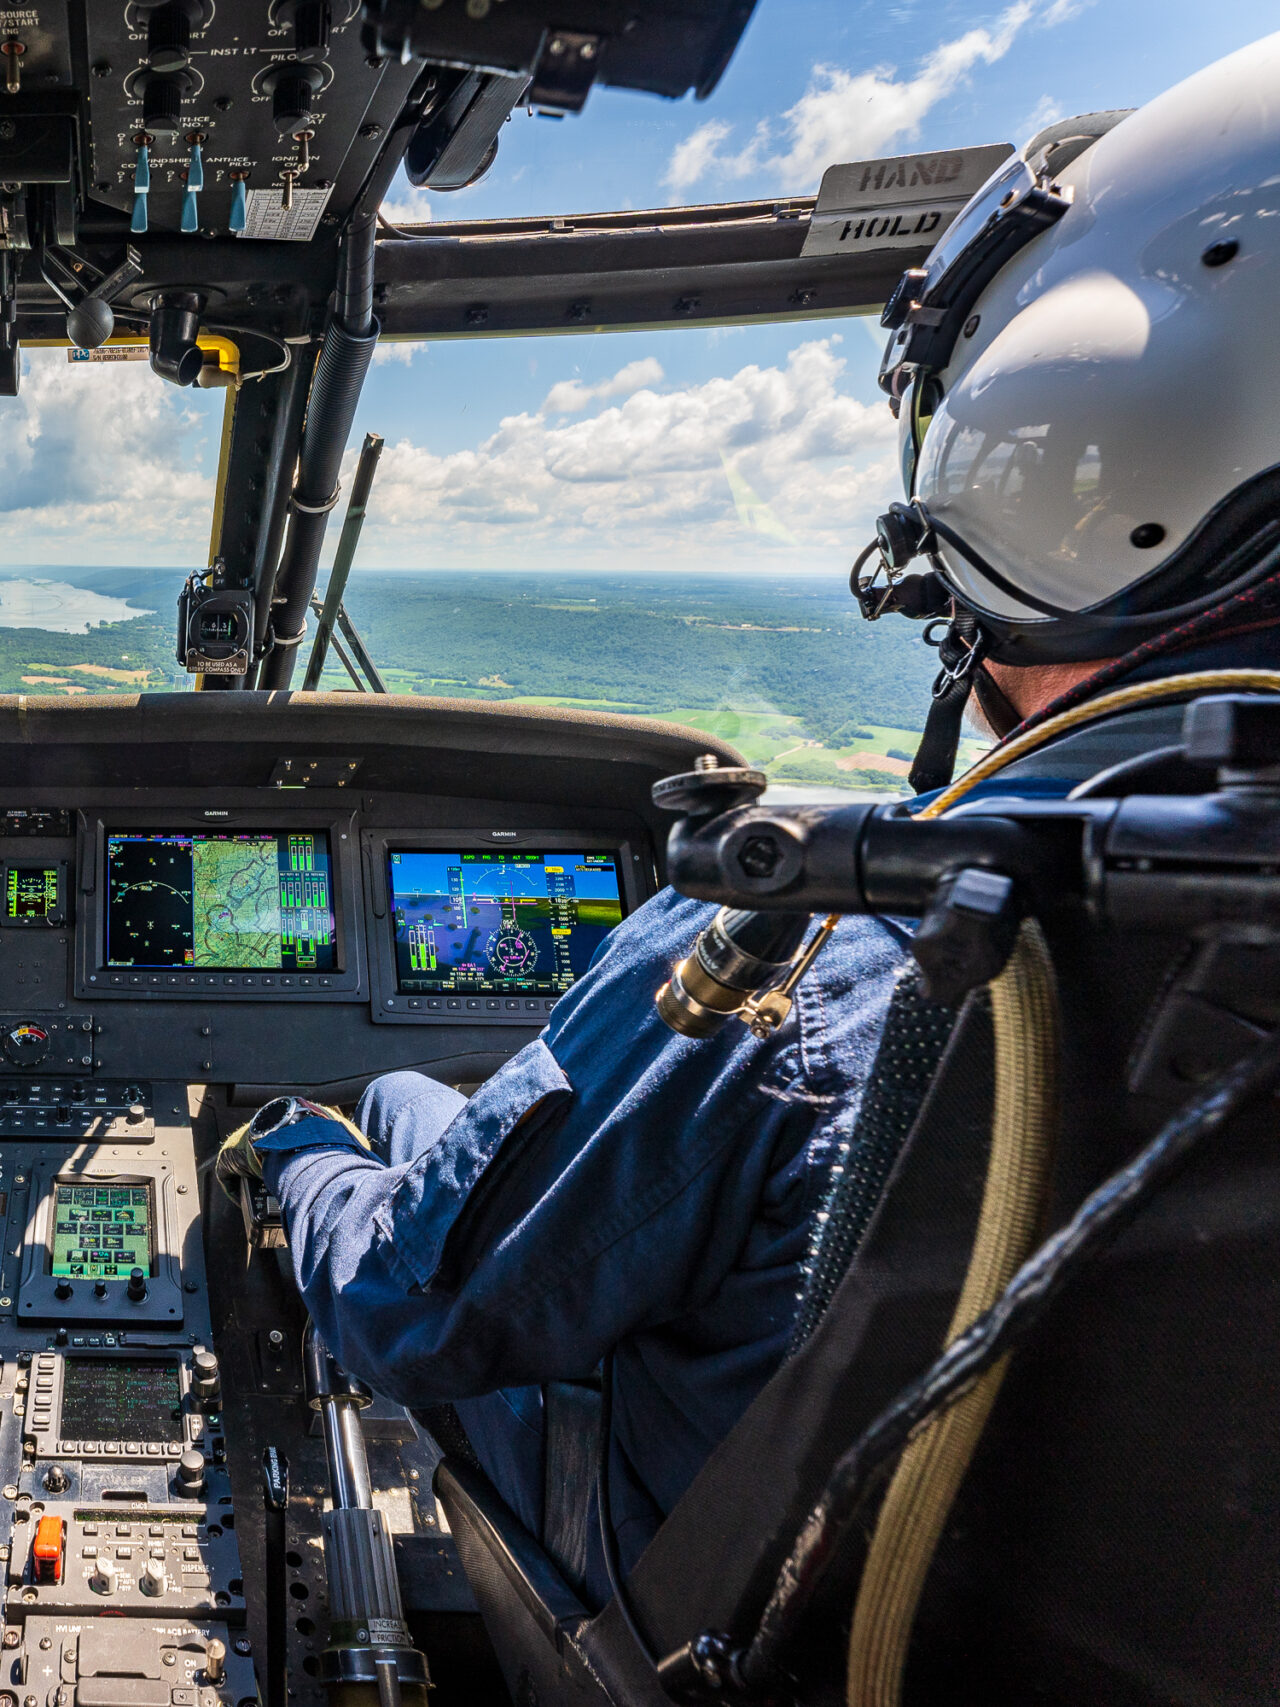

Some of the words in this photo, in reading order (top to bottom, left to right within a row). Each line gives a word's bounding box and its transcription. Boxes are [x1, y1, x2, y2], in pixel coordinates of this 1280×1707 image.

[0, 10, 39, 19] SOURCE
[210, 48, 238, 56] INST
[243, 47, 257, 55] LT
[270, 53, 297, 61] PILO
[859, 156, 964, 191] HAND
[839, 211, 942, 241] HOLD
[270, 1459, 281, 1489] PARKING
[181, 1564, 210, 1572] DISPENSE
[376, 1633, 405, 1642] FRICTION
